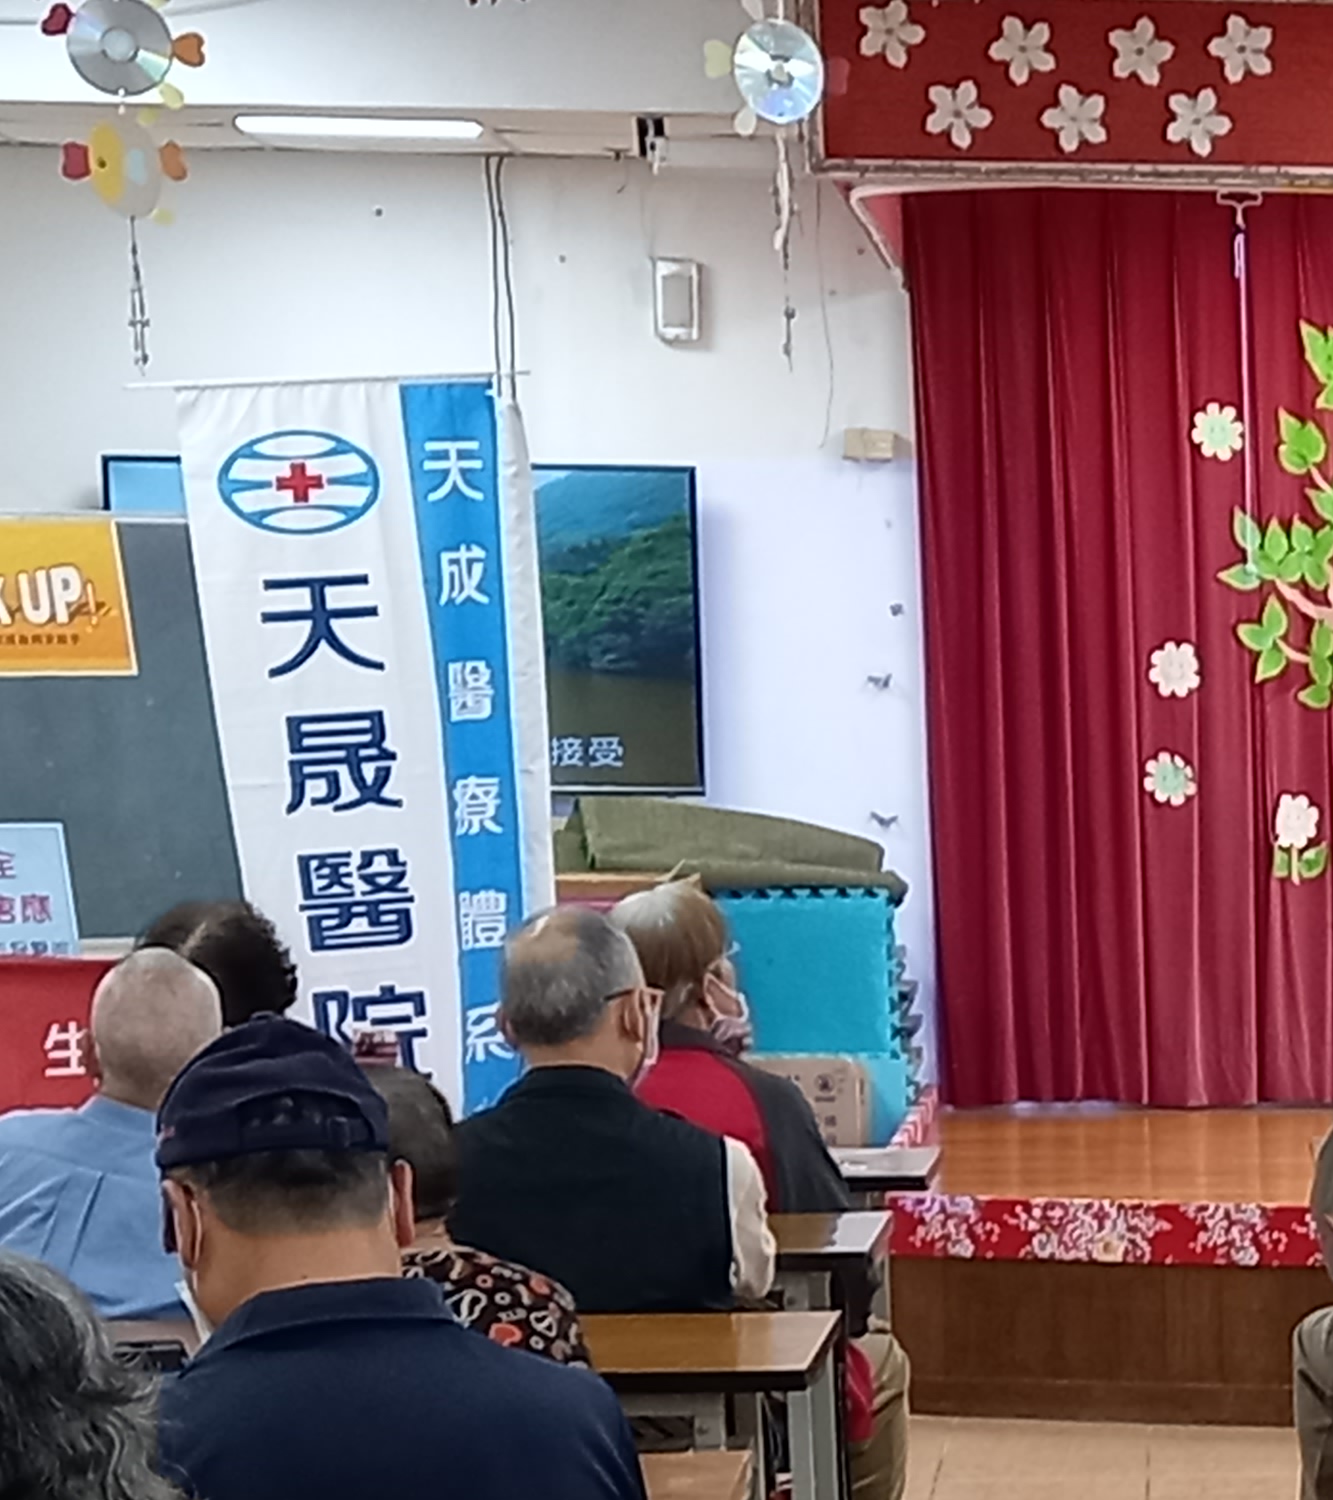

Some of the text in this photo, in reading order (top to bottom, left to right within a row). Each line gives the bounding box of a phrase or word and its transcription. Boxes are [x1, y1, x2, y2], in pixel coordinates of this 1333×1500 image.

[260, 572, 433, 1080] 天晟醫院
[421, 438, 518, 1112] 天成醫療體系
[551, 735, 624, 768] 接受
